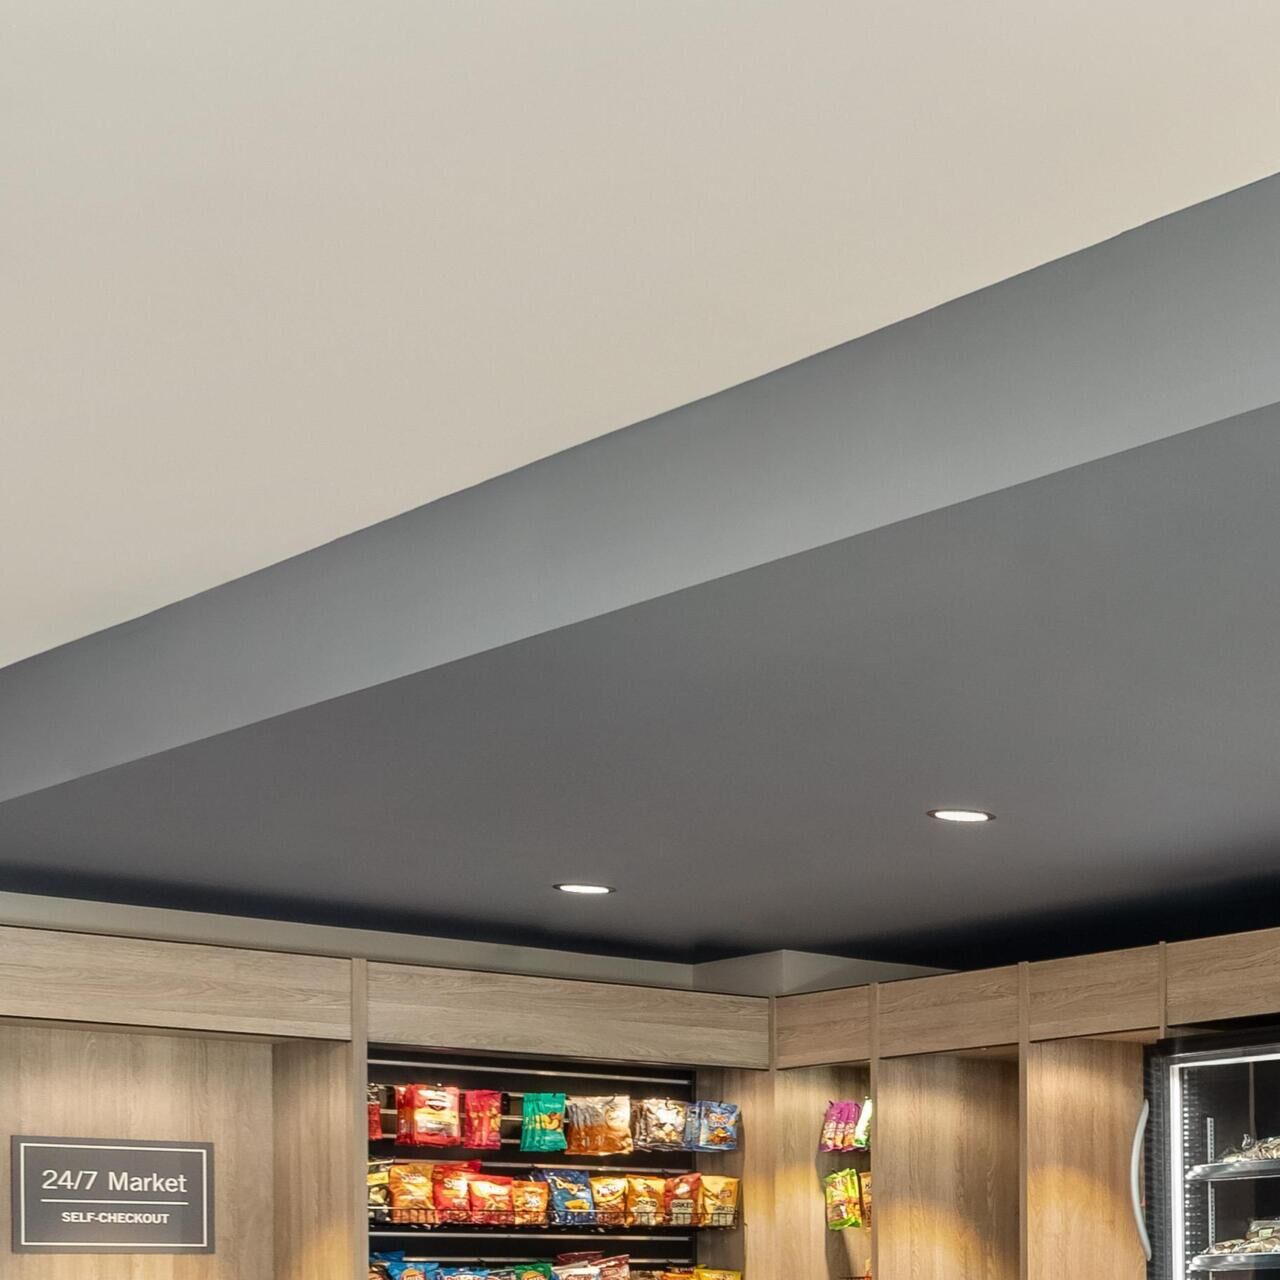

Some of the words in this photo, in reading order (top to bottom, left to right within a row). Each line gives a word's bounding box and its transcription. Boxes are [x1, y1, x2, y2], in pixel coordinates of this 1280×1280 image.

[41, 1169, 98, 1190] 24/7
[108, 1171, 188, 1193] Market
[61, 1211, 170, 1224] SELF-CHECKOUT
